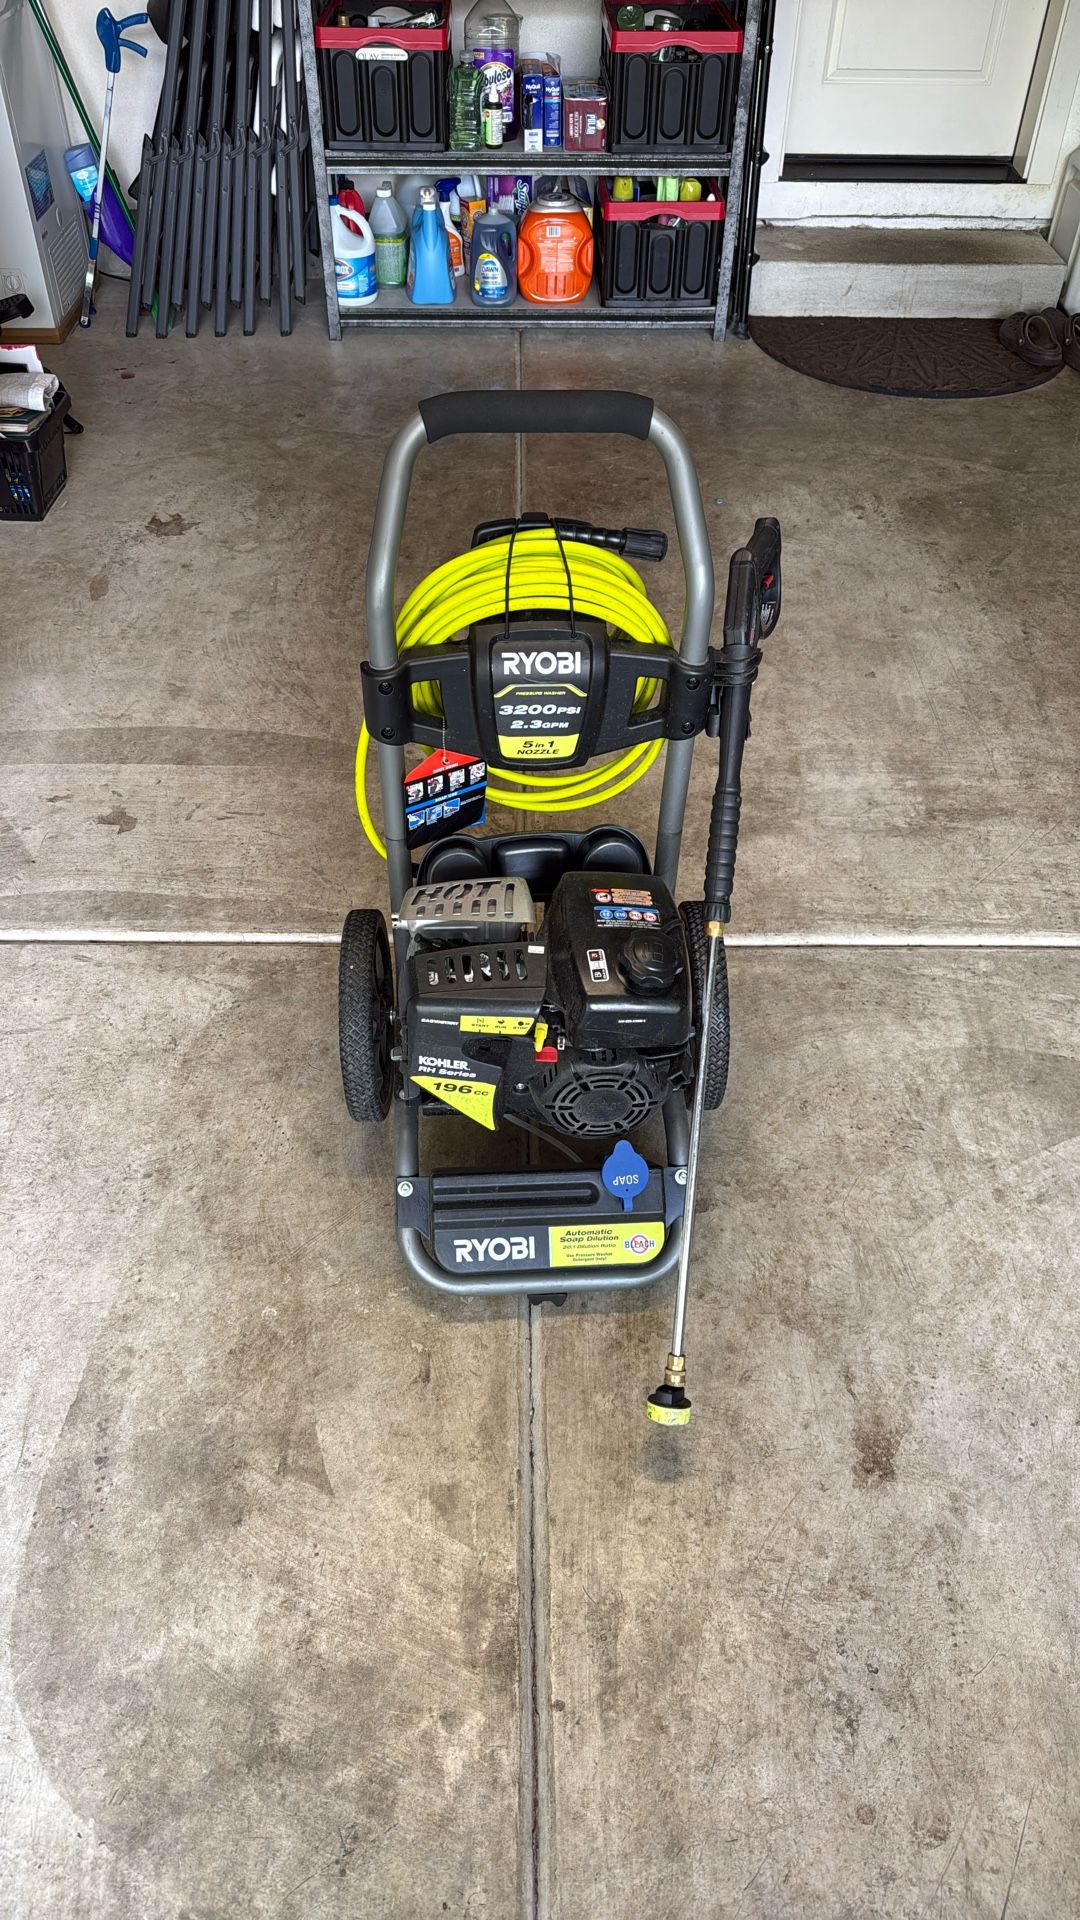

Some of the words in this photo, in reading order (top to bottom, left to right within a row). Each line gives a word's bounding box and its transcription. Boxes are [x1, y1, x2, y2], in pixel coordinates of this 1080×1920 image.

[483, 69, 512, 86] buloso
[501, 651, 582, 675] RYOBI
[411, 880, 502, 906] HOT
[438, 1068, 477, 1078] Series
[612, 1174, 640, 1185] SOAP
[453, 1236, 536, 1263] RYOBI
[624, 1240, 655, 1249] BLEACH
